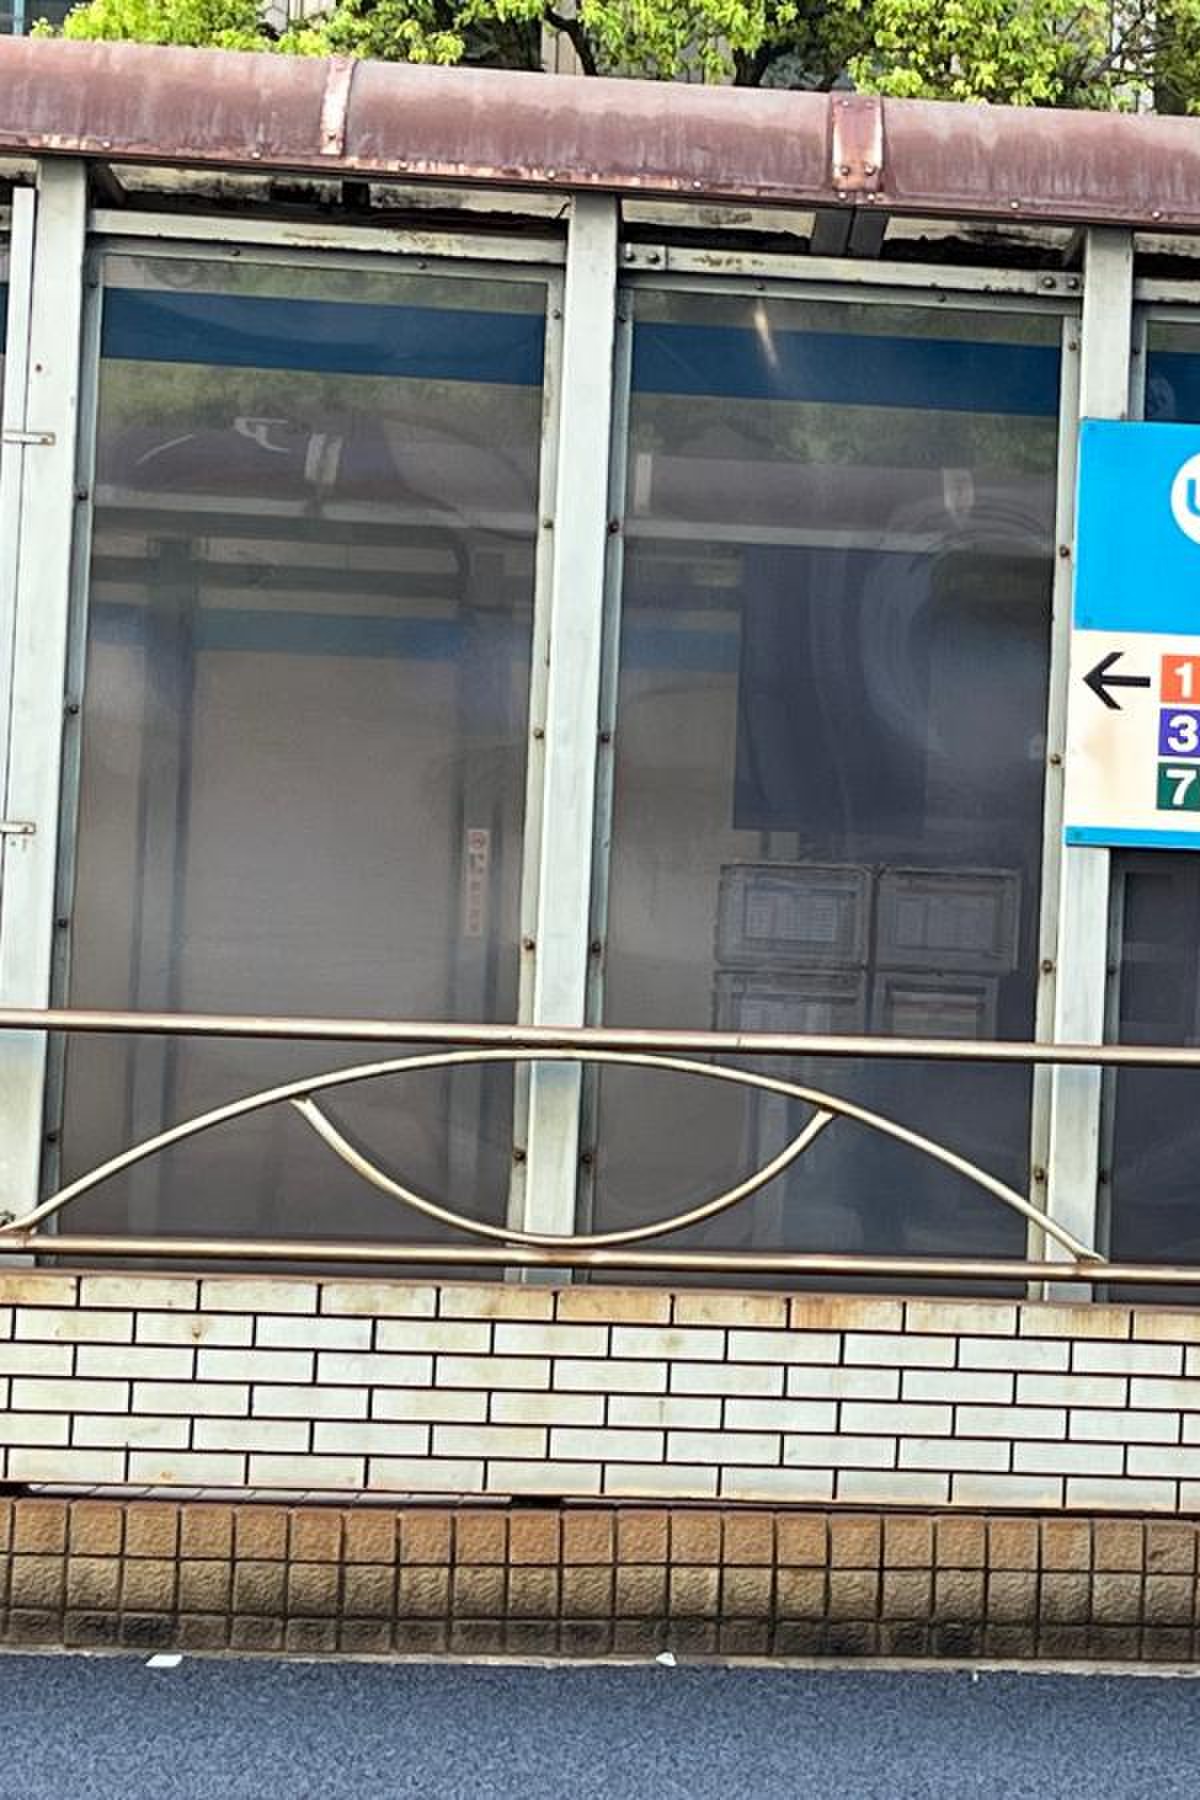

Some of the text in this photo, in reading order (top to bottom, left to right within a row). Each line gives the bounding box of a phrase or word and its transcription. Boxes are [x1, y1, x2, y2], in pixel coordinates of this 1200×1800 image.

[1173, 661, 1192, 699] 1
[1167, 714, 1200, 752] 3
[1165, 768, 1198, 806] 7
